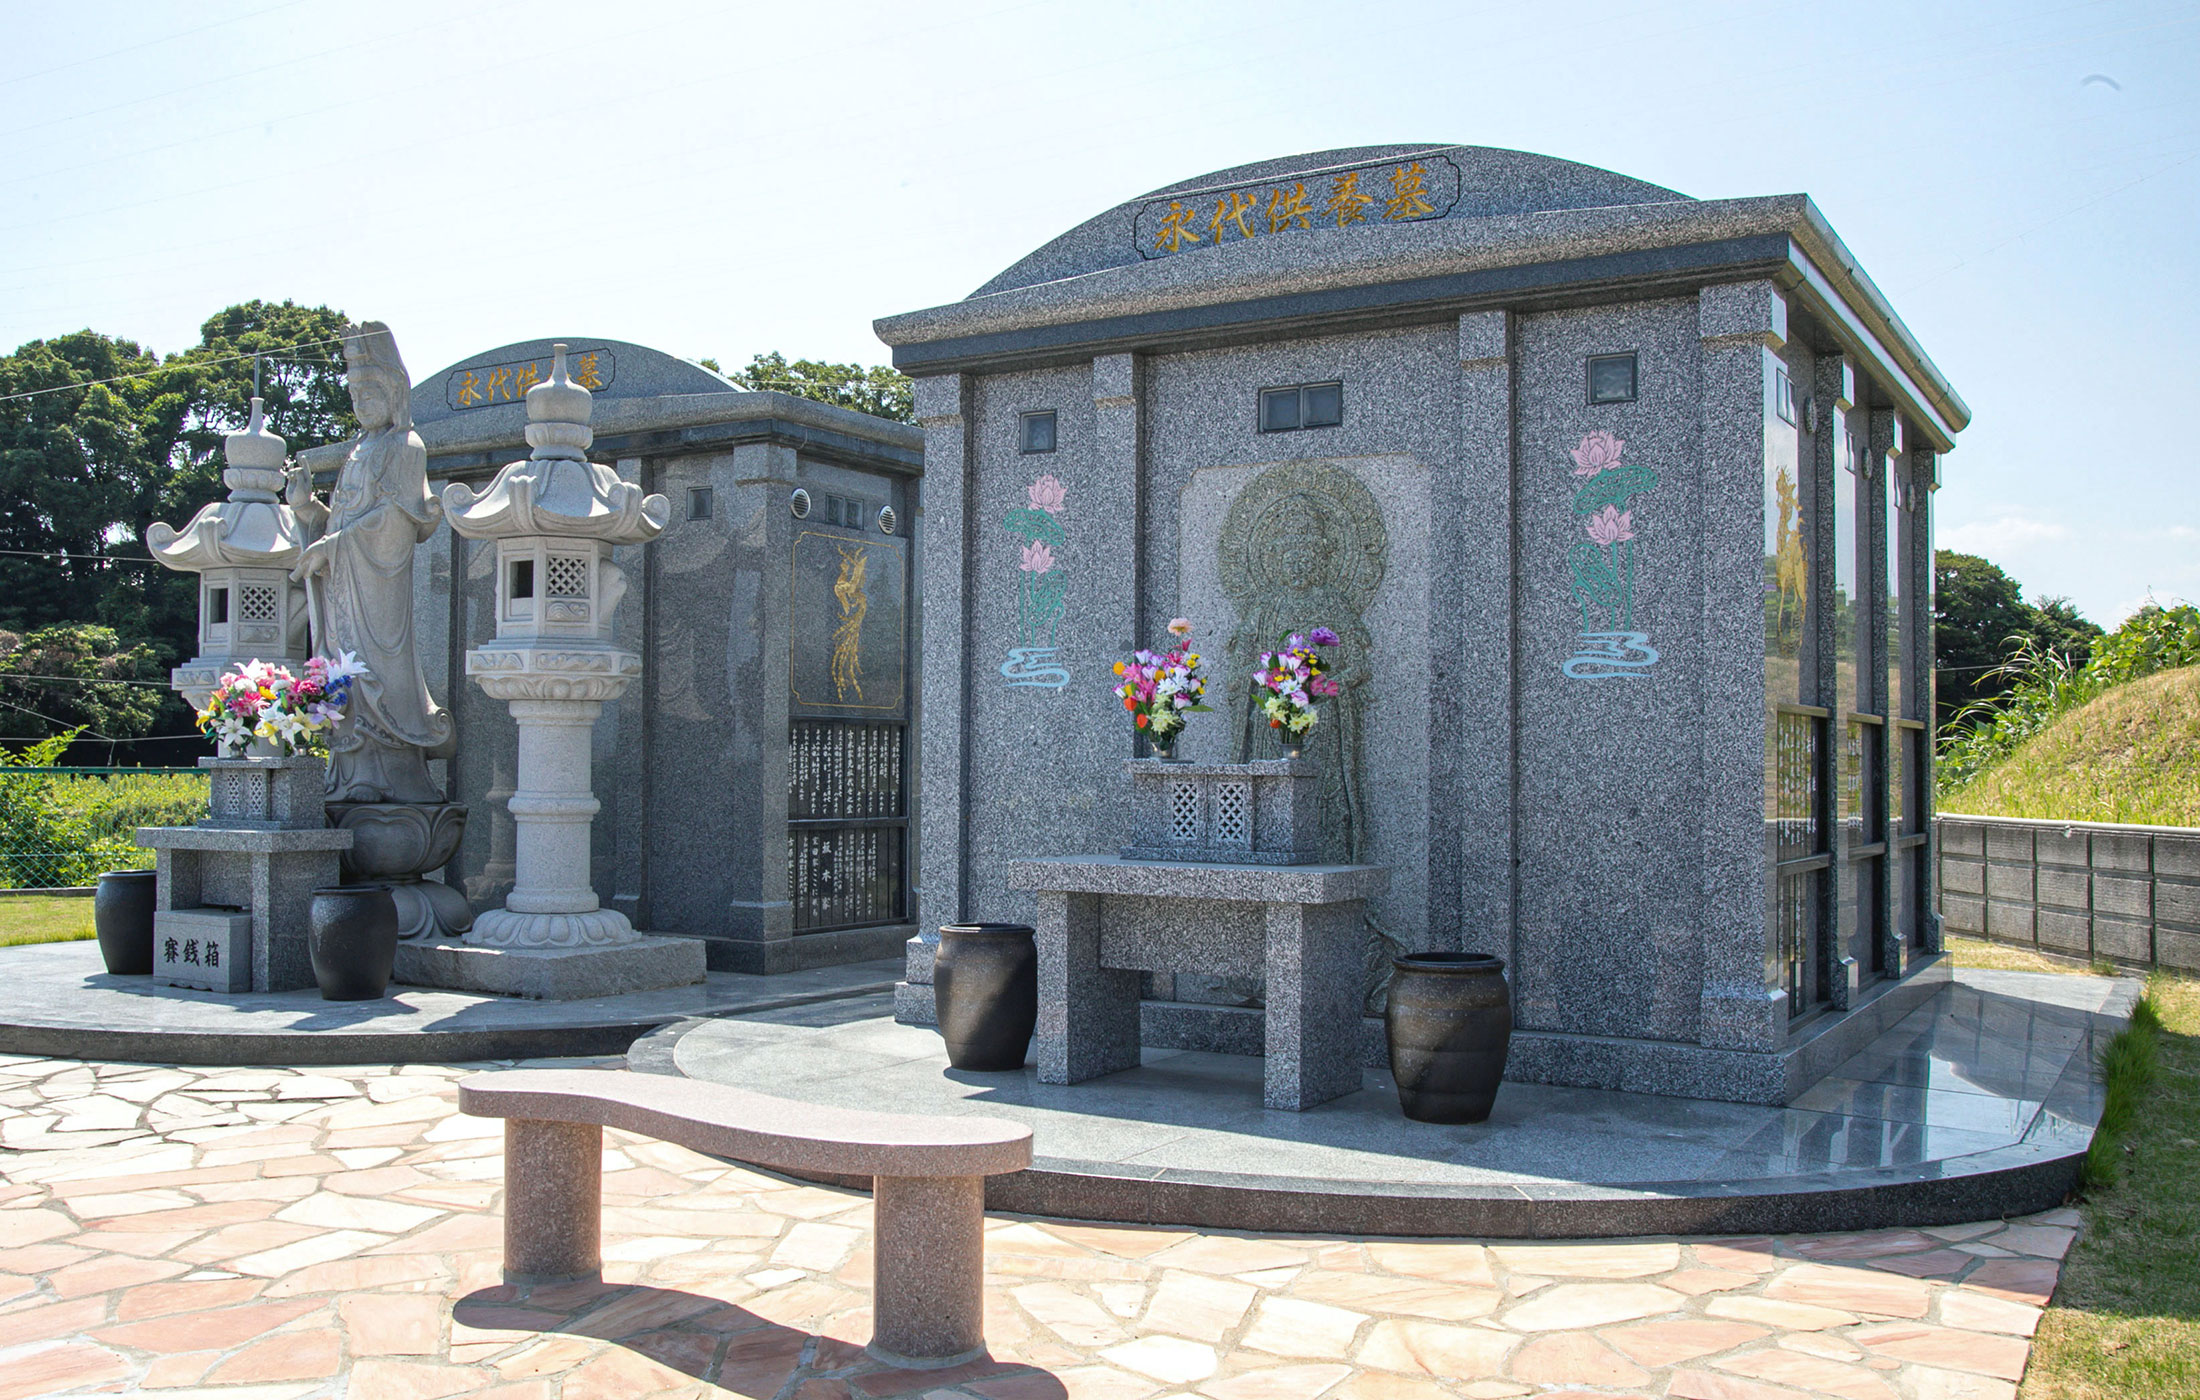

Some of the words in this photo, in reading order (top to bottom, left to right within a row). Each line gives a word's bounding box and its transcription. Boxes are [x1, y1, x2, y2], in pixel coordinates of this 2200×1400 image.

[1154, 162, 1436, 254] 永代供養墓
[457, 352, 604, 406] 永代供墓
[163, 935, 220, 968] 賽銭箱
